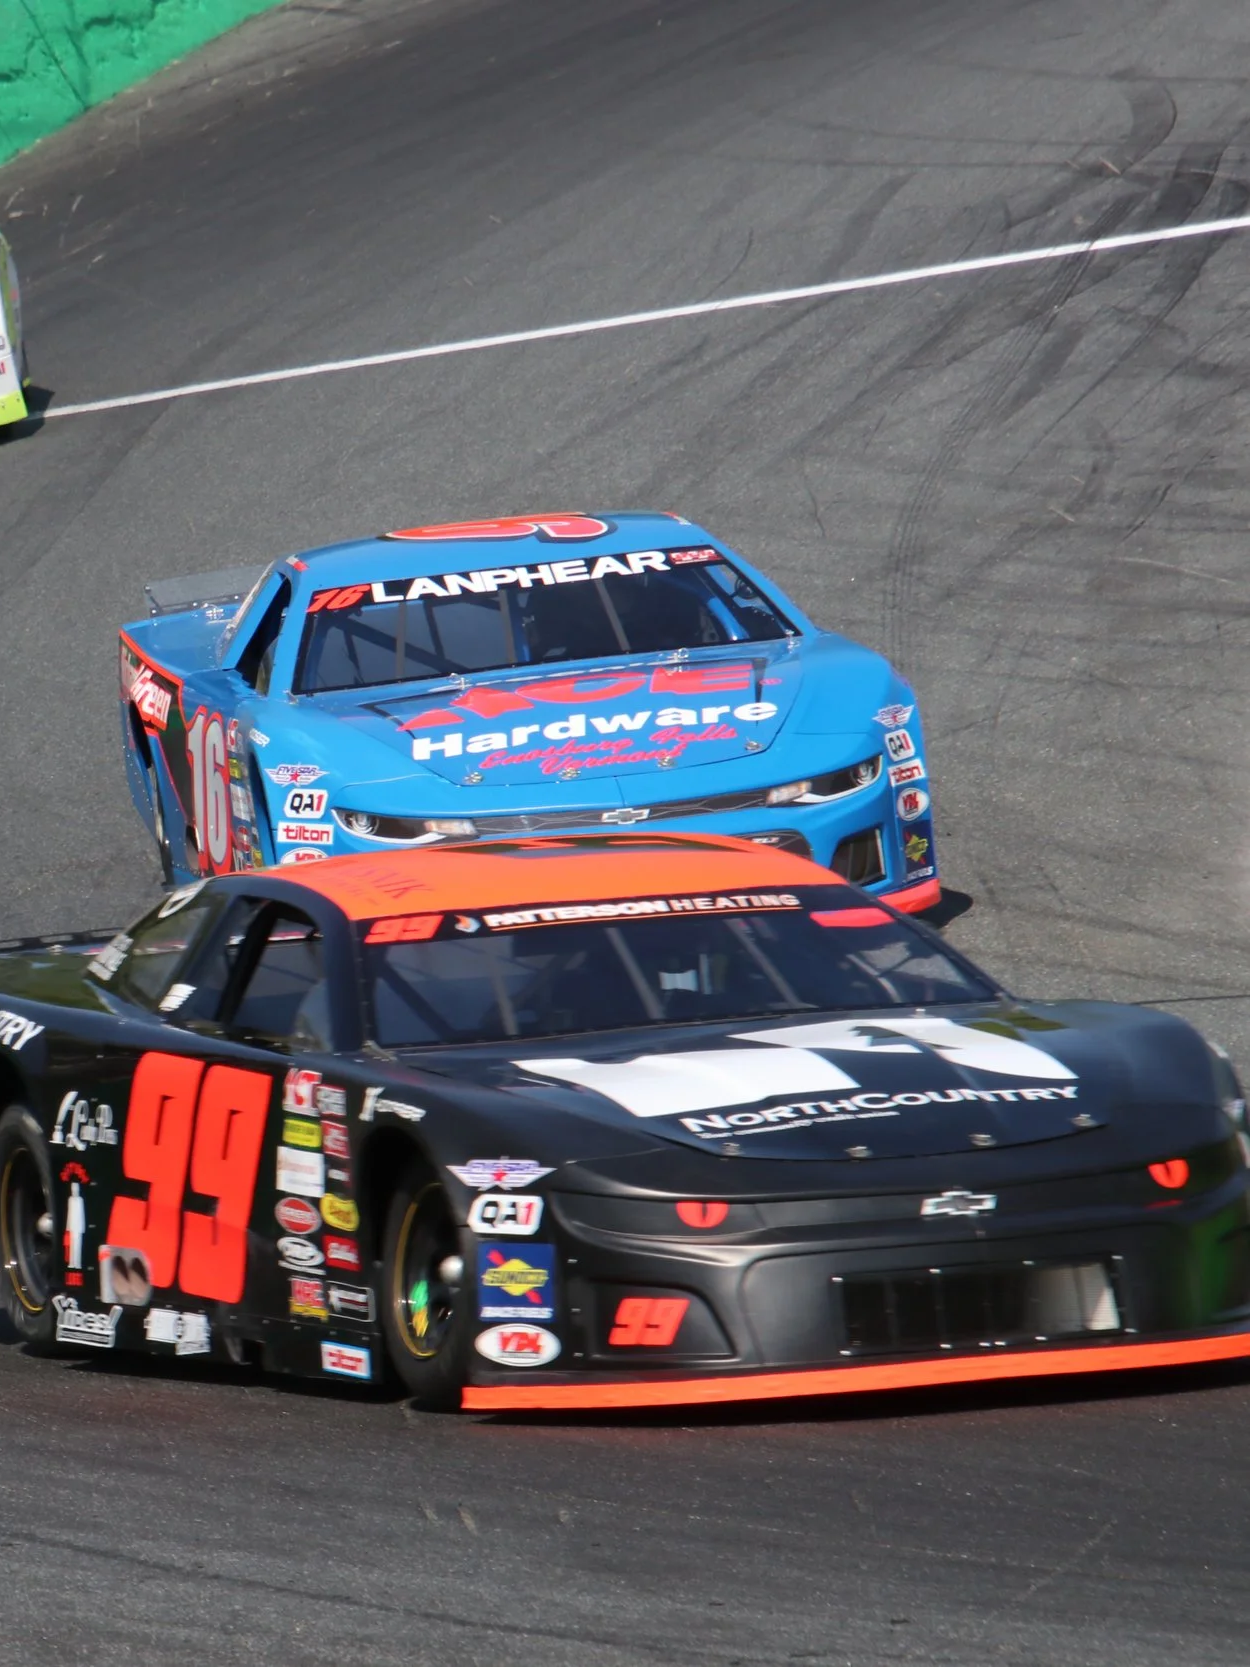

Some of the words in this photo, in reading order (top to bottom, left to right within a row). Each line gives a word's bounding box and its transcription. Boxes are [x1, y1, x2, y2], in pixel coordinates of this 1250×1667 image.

[307, 583, 372, 613] 16
[371, 550, 672, 603] LANPHEAR
[397, 663, 754, 732] ACE
[413, 701, 778, 761] Hardware
[186, 706, 232, 872] 16
[290, 793, 324, 814] QA1
[283, 825, 330, 842] tilton
[364, 914, 445, 944] 99
[486, 899, 669, 928] PATTERSON
[668, 893, 800, 912] HEATING
[107, 1051, 273, 1304] 99
[481, 1200, 534, 1229] QA1
[608, 1297, 690, 1346] 99
